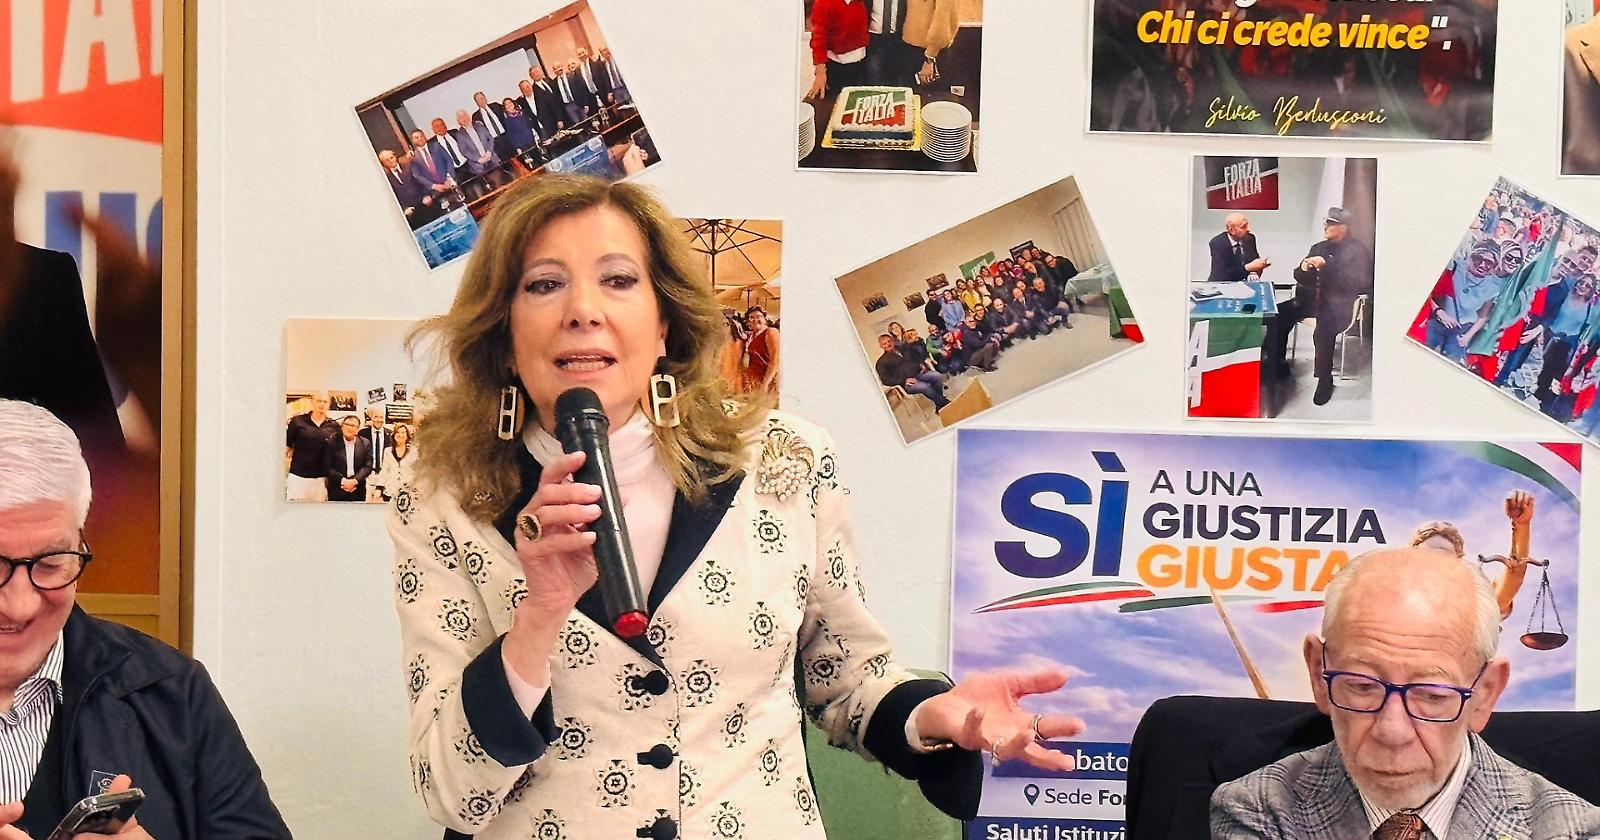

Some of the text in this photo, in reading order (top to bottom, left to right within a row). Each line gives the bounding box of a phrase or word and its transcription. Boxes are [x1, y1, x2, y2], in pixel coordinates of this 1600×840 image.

[1137, 10, 1195, 43] Chi
[1197, 12, 1230, 45] ci
[1233, 13, 1332, 47] crede
[852, 102, 895, 124] ITALIA
[855, 92, 894, 112] FORZA
[1205, 96, 1387, 136] Silvio Berlusconi
[1223, 158, 1260, 186] FORZA
[1225, 174, 1262, 202] ITALIA
[1149, 469, 1263, 497] A UNA
[994, 451, 1130, 579] SÌ
[1142, 502, 1387, 545] GIUSTIZIA
[1076, 748, 1129, 772] bato
[1044, 787, 1092, 806] Sede
[986, 823, 1125, 840] Saluti Istituzi
